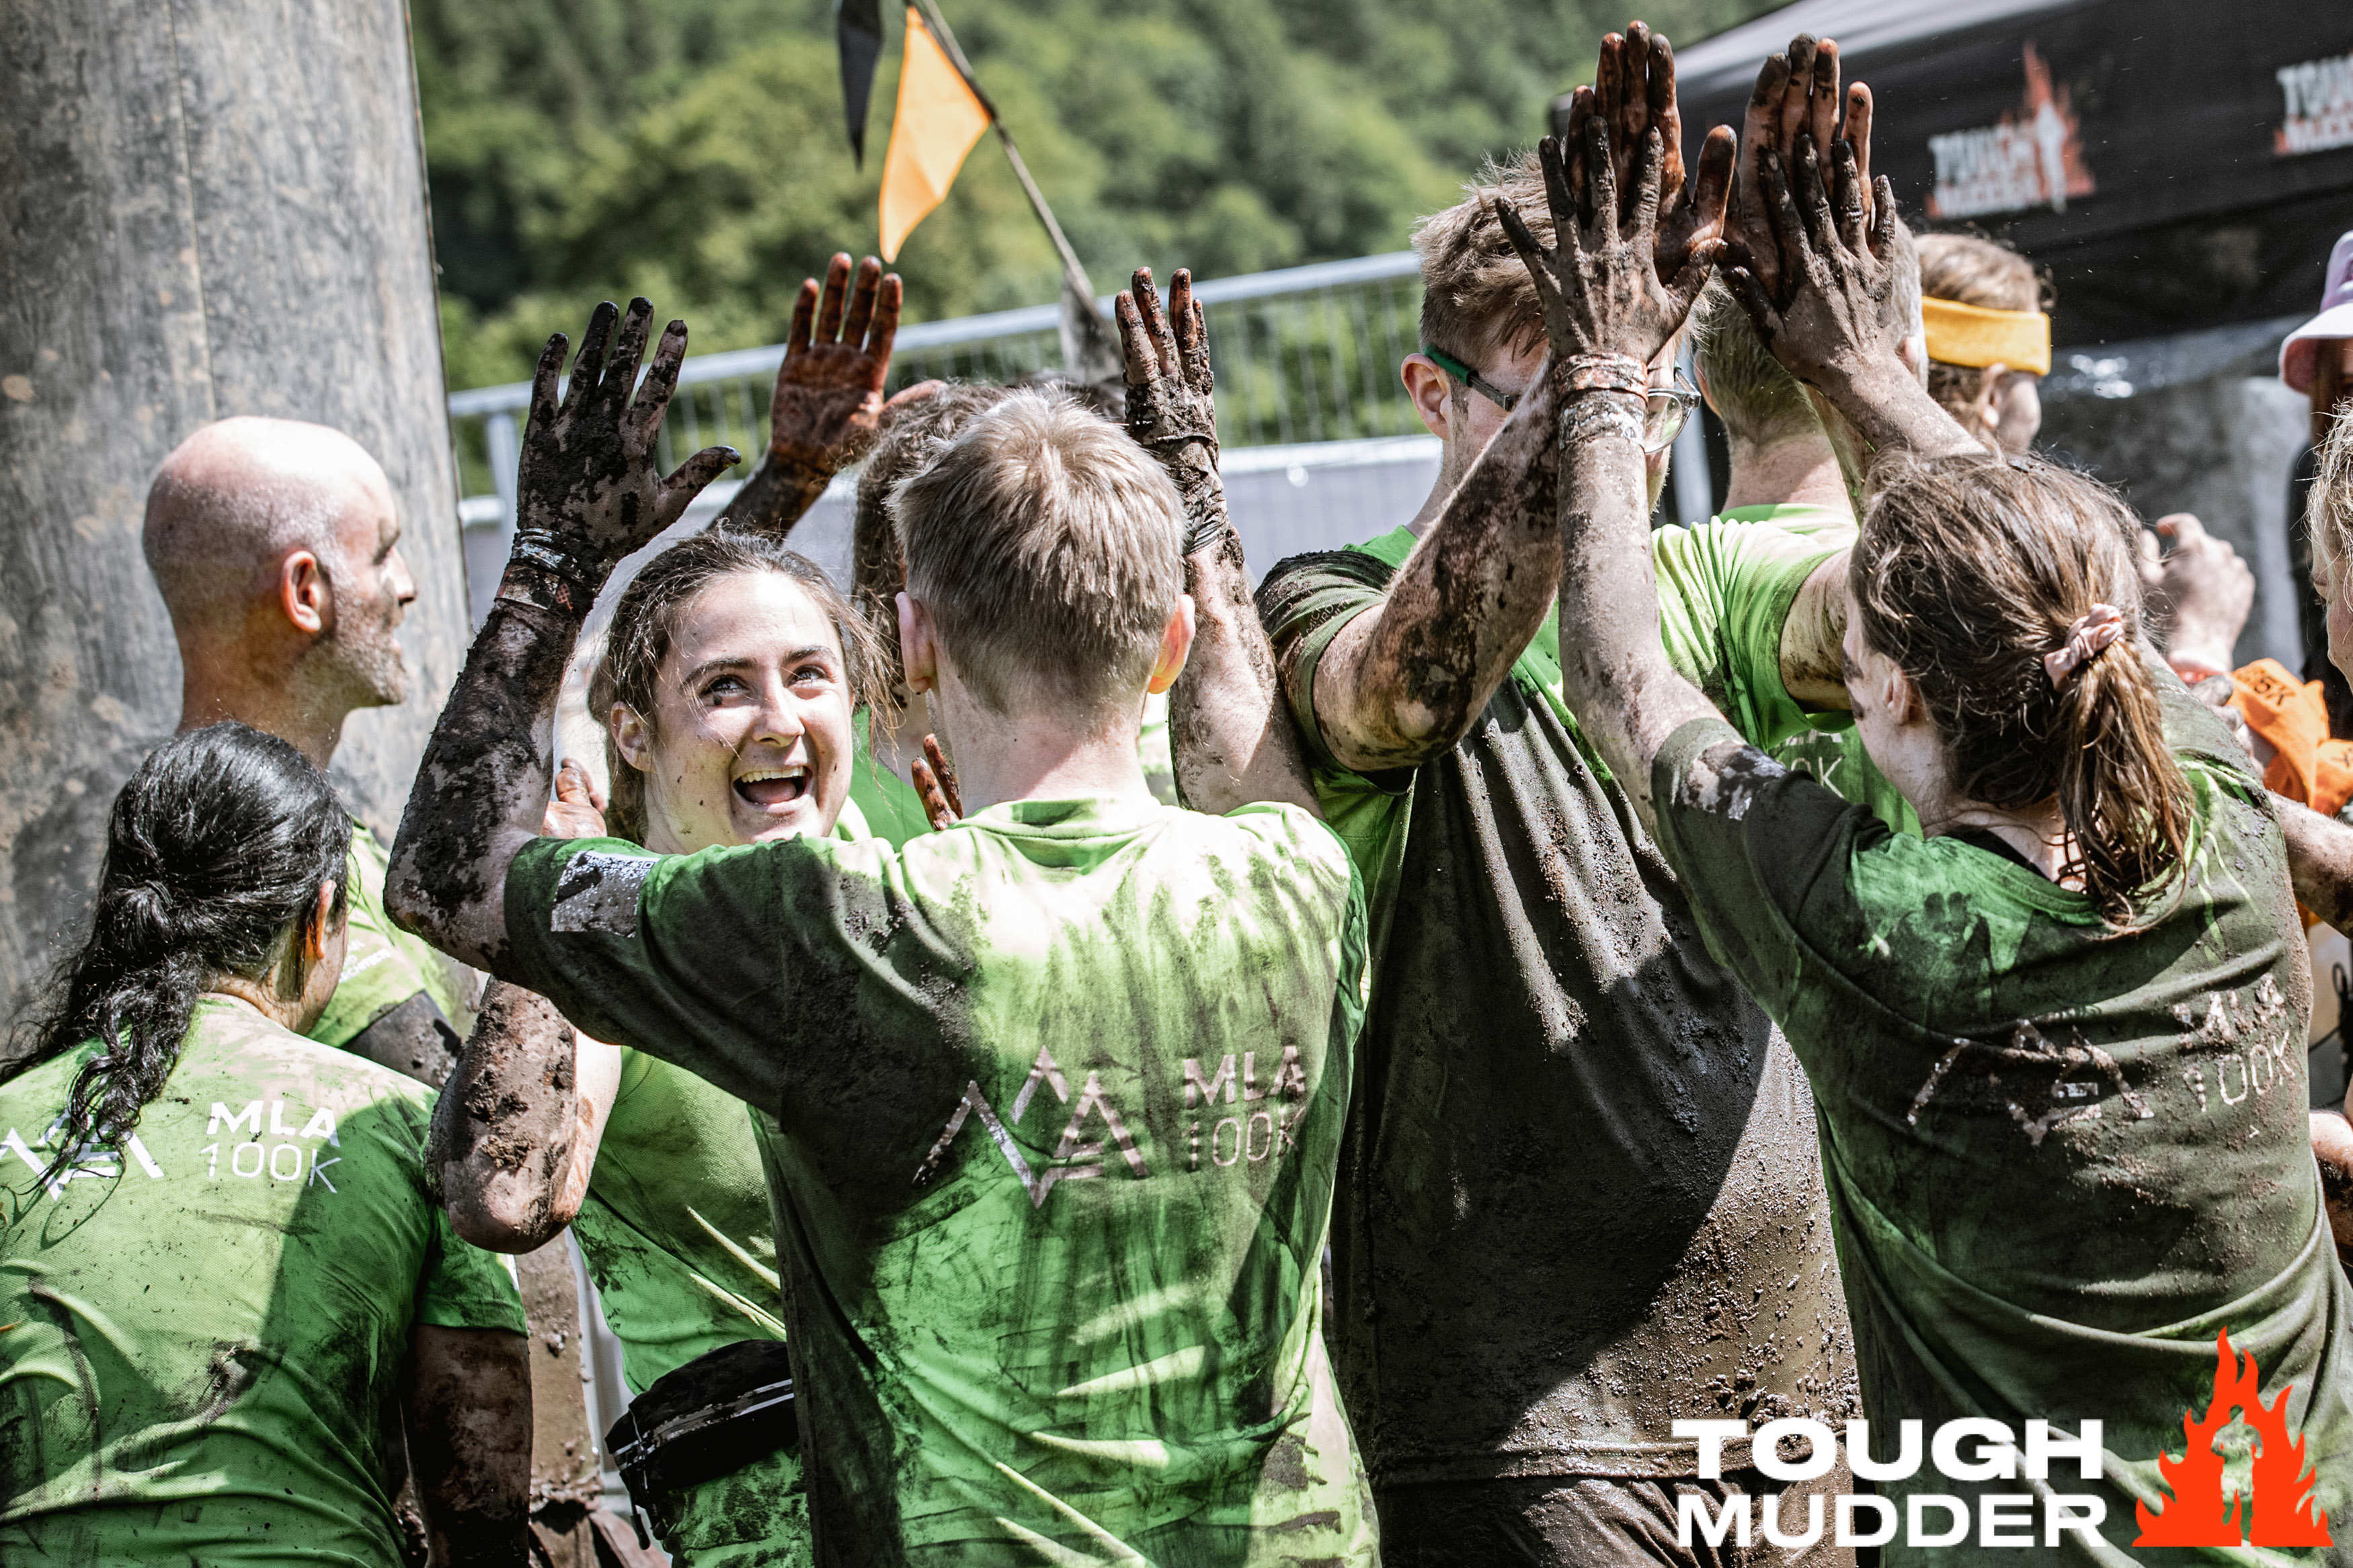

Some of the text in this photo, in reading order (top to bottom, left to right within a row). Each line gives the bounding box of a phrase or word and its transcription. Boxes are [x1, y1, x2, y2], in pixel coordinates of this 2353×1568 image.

[1183, 1045, 1306, 1110] MLA
[2182, 1029, 2296, 1113] 100K
[206, 1100, 340, 1147] MLA
[1181, 1106, 1306, 1171] 100K
[200, 1142, 342, 1194] 100K
